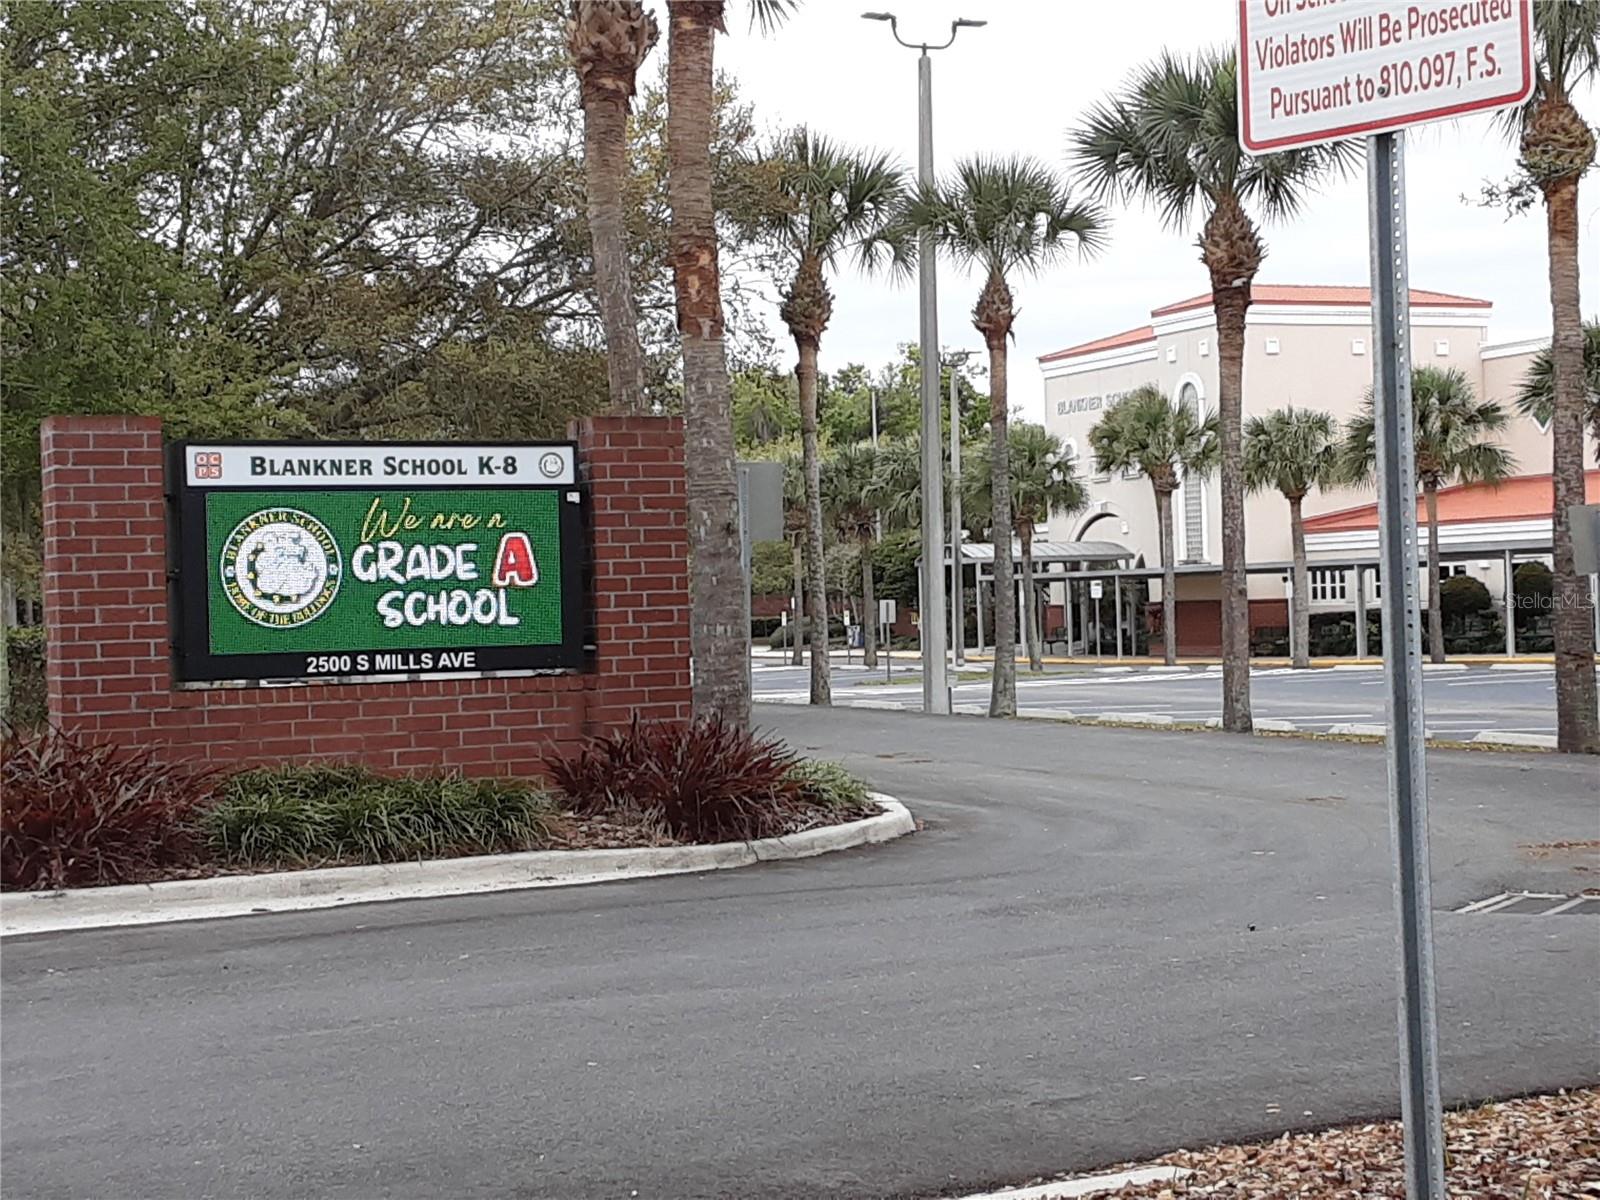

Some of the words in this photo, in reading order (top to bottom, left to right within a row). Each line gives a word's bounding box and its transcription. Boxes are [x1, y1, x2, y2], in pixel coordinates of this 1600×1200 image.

[1256, 33, 1335, 70] Violators
[1340, 15, 1373, 54] Will
[1378, 13, 1402, 46] Be
[1407, 0, 1512, 40] Prosecuted
[1270, 76, 1352, 119] Pursuant
[1356, 73, 1375, 103] to
[1467, 42, 1502, 81] F.S.
[250, 456, 373, 476] BLANKNER
[383, 456, 468, 476] SCHOOL
[478, 456, 518, 476] K-8
[361, 497, 421, 543] We
[430, 513, 480, 529] are
[352, 540, 479, 584] GRADE
[493, 532, 539, 587] A
[377, 588, 520, 628] SCHOOL
[307, 655, 351, 673] 2500
[356, 654, 370, 671] S
[375, 653, 433, 670] MILLS
[438, 652, 476, 669] AVE
